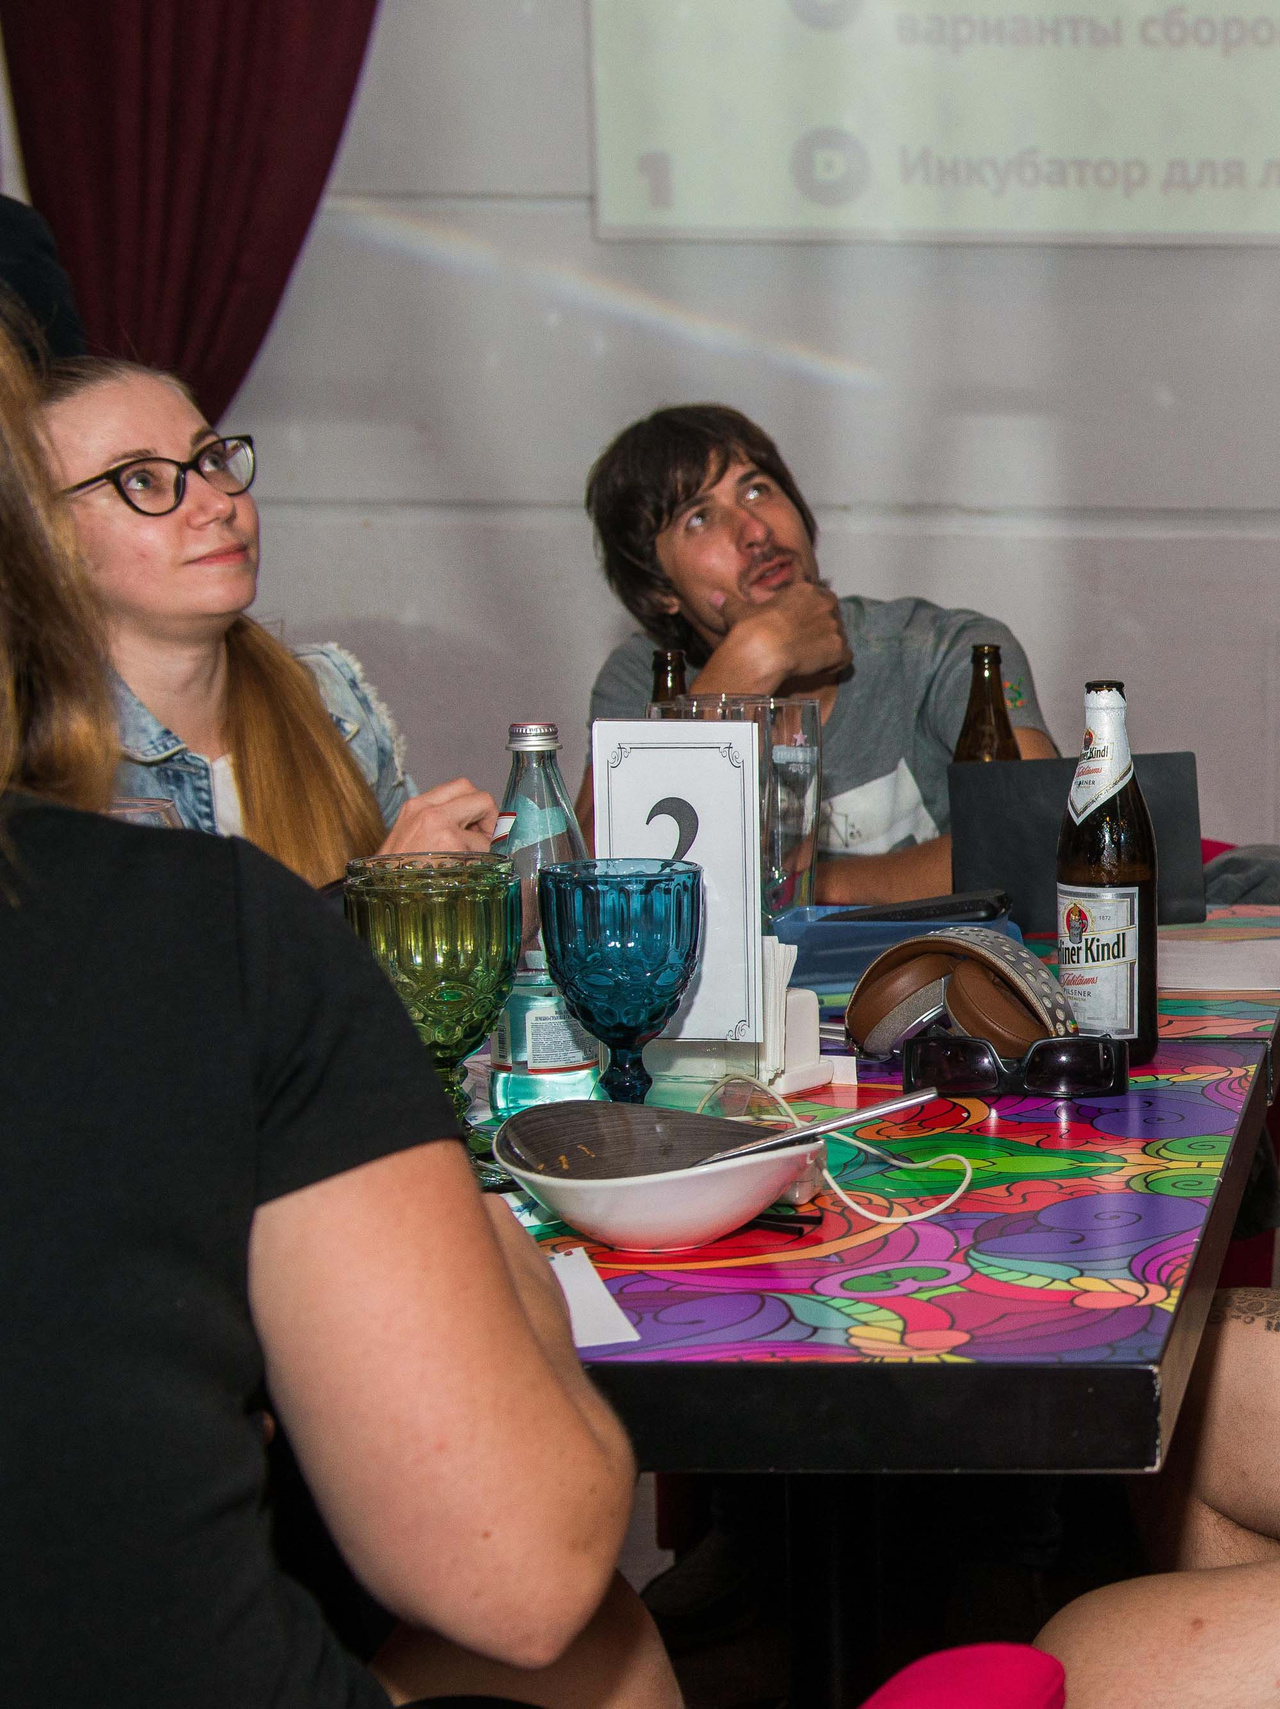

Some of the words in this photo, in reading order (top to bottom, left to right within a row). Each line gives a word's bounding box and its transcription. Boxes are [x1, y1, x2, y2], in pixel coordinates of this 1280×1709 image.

[899, 12, 1122, 54] варианты
[636, 151, 672, 209] 1
[899, 145, 1146, 198] Инкубатор
[1160, 155, 1247, 196] для
[645, 796, 700, 866] 2
[1084, 932, 1126, 964] Kindl
